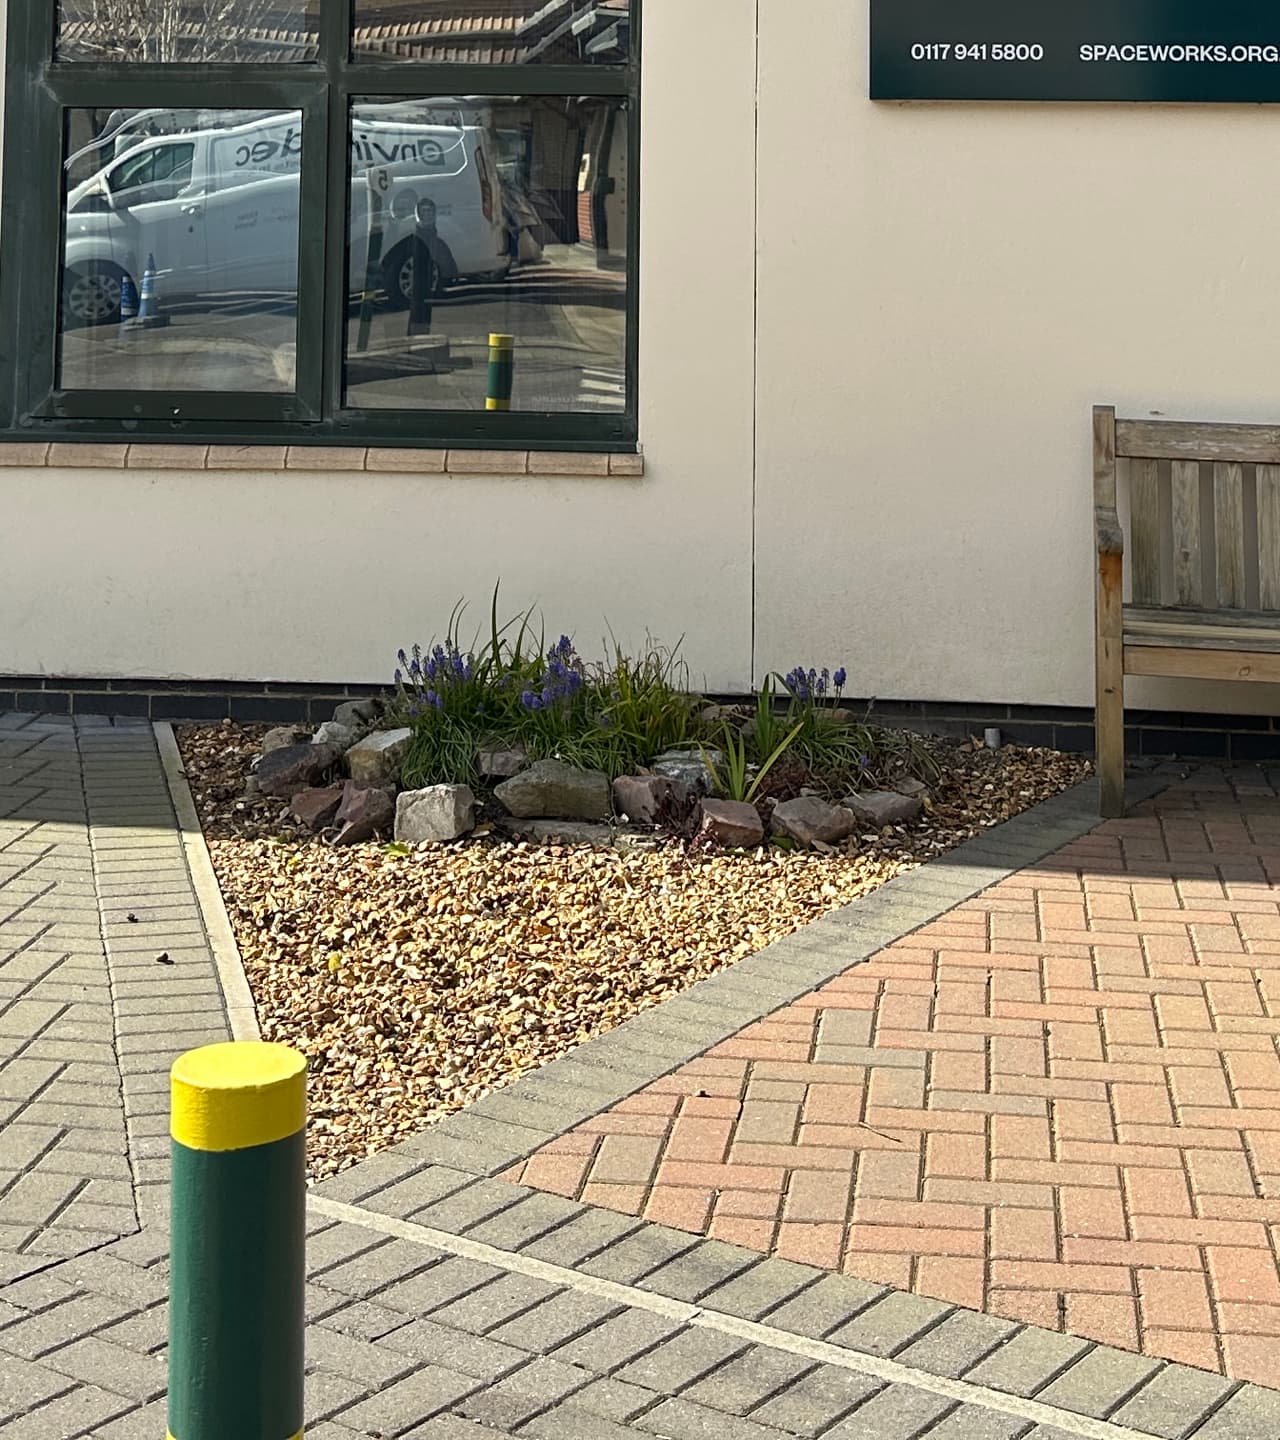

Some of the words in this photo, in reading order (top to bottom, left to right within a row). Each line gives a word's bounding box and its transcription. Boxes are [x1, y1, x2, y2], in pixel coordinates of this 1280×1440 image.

[910, 42, 951, 62] 0117
[953, 42, 987, 62] 941
[990, 42, 1045, 62] 5800
